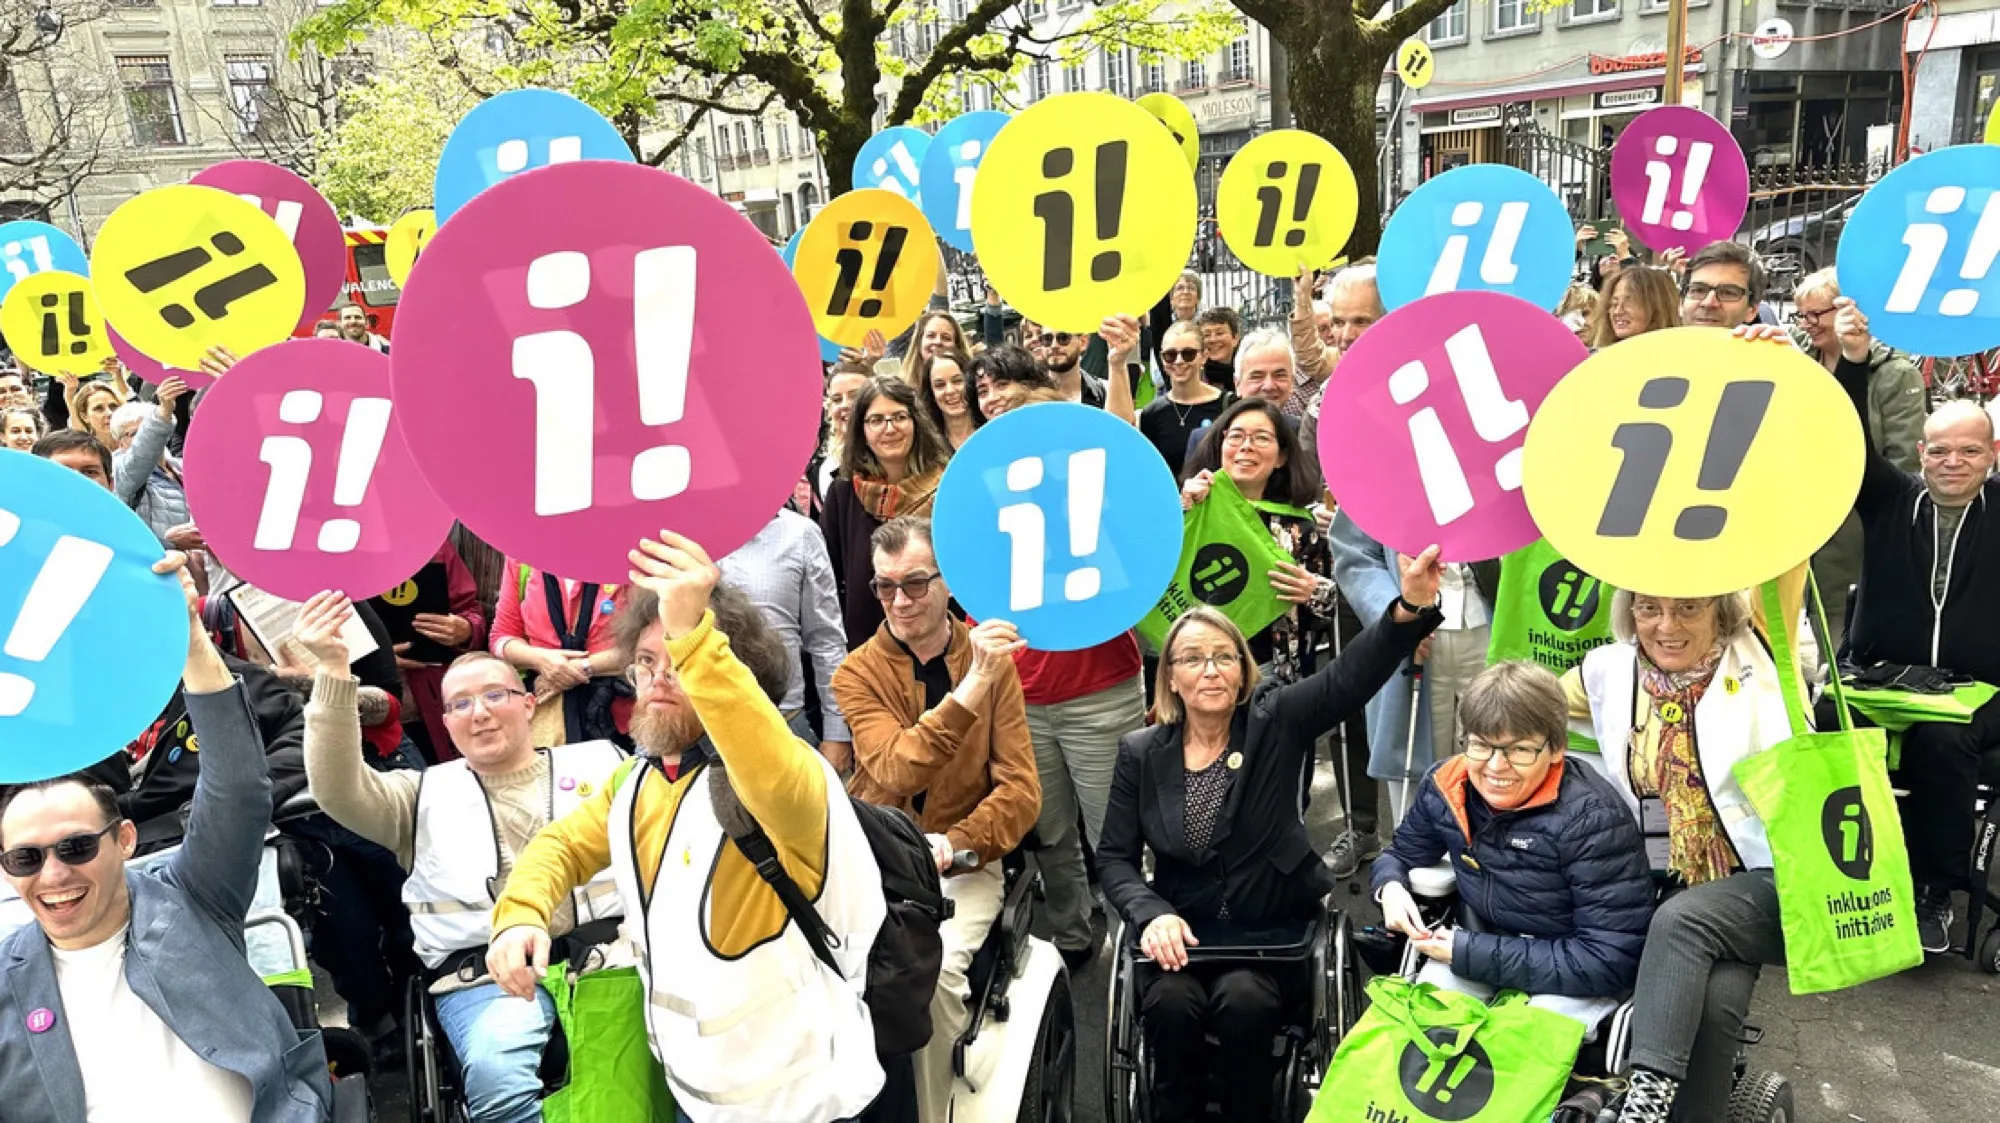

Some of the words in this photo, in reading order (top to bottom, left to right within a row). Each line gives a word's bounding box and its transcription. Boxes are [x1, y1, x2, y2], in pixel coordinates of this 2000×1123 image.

[1034, 140, 1128, 292] i!
[1254, 161, 1321, 247] i!
[1642, 136, 1713, 231] i!
[827, 221, 908, 318] i!
[512, 245, 697, 517] i!
[254, 389, 393, 553] i!
[1597, 377, 1775, 540] i!
[999, 448, 1107, 612] i!
[1551, 571, 1596, 618] i!
[1533, 647, 1585, 670] initiat
